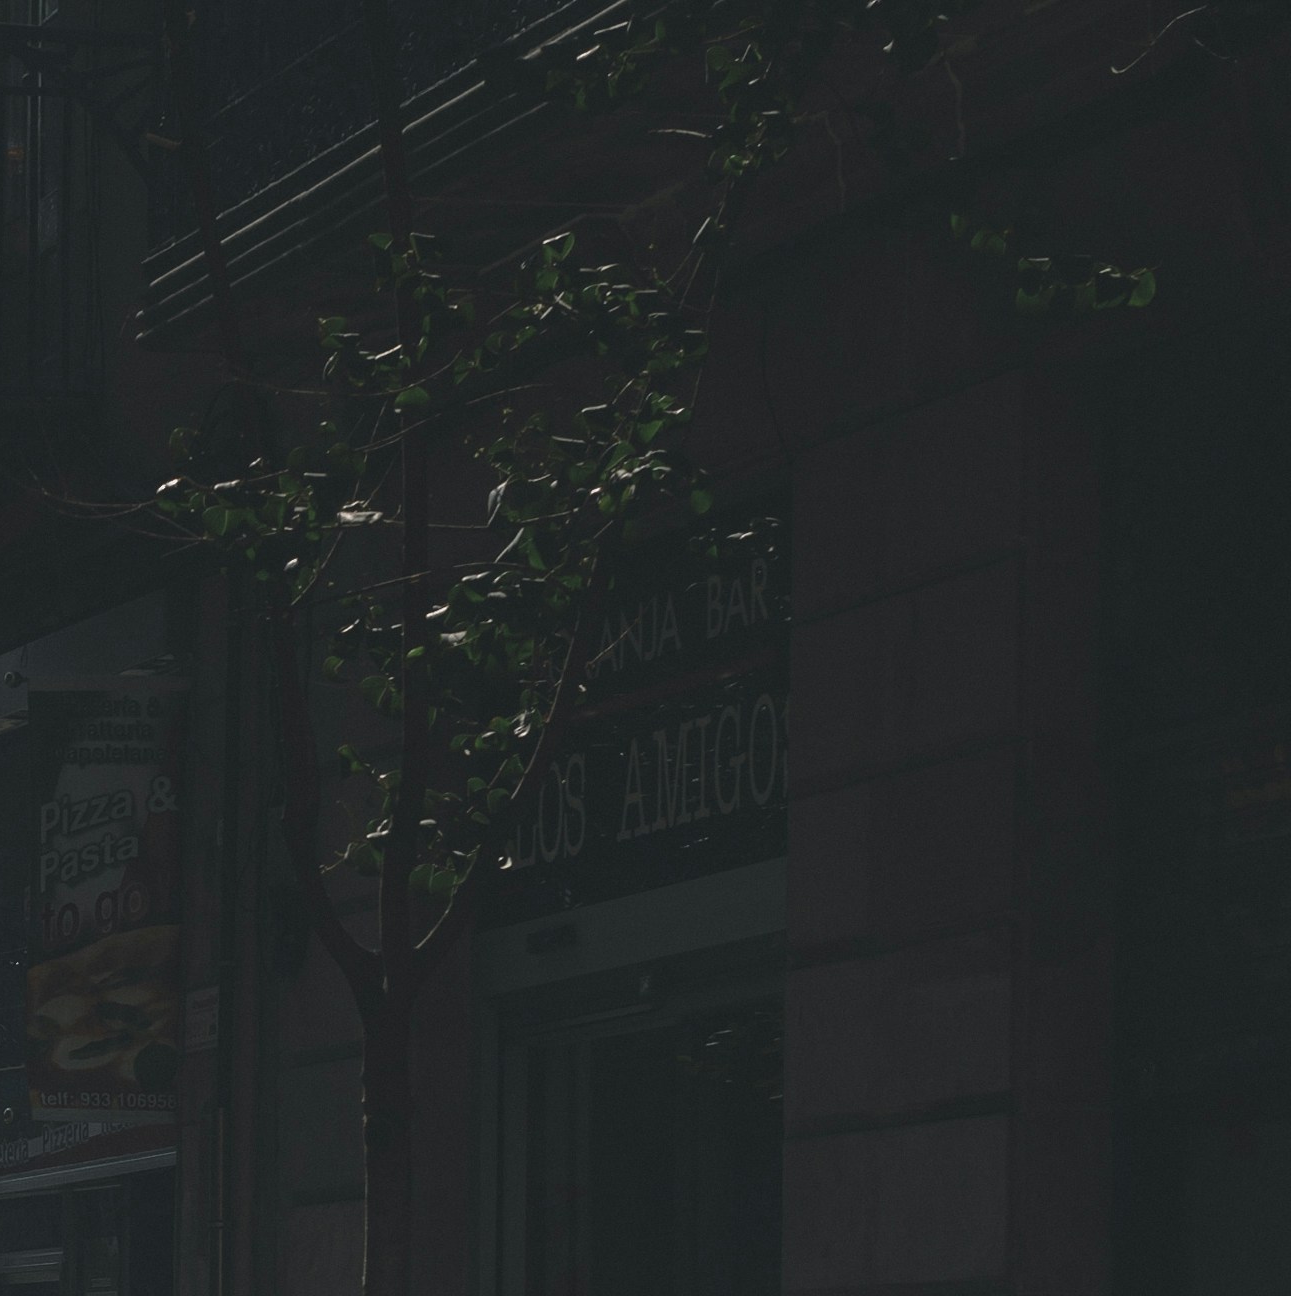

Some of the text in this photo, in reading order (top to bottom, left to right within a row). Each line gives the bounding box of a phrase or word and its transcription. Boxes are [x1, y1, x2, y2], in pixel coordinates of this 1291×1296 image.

[706, 557, 770, 640] BAR
[615, 693, 789, 843] AMIGO
[39, 776, 180, 845] Pizza &
[39, 833, 139, 893] Pasta
[40, 880, 151, 943] to go
[40, 1091, 177, 1109] telf: 933 106958
